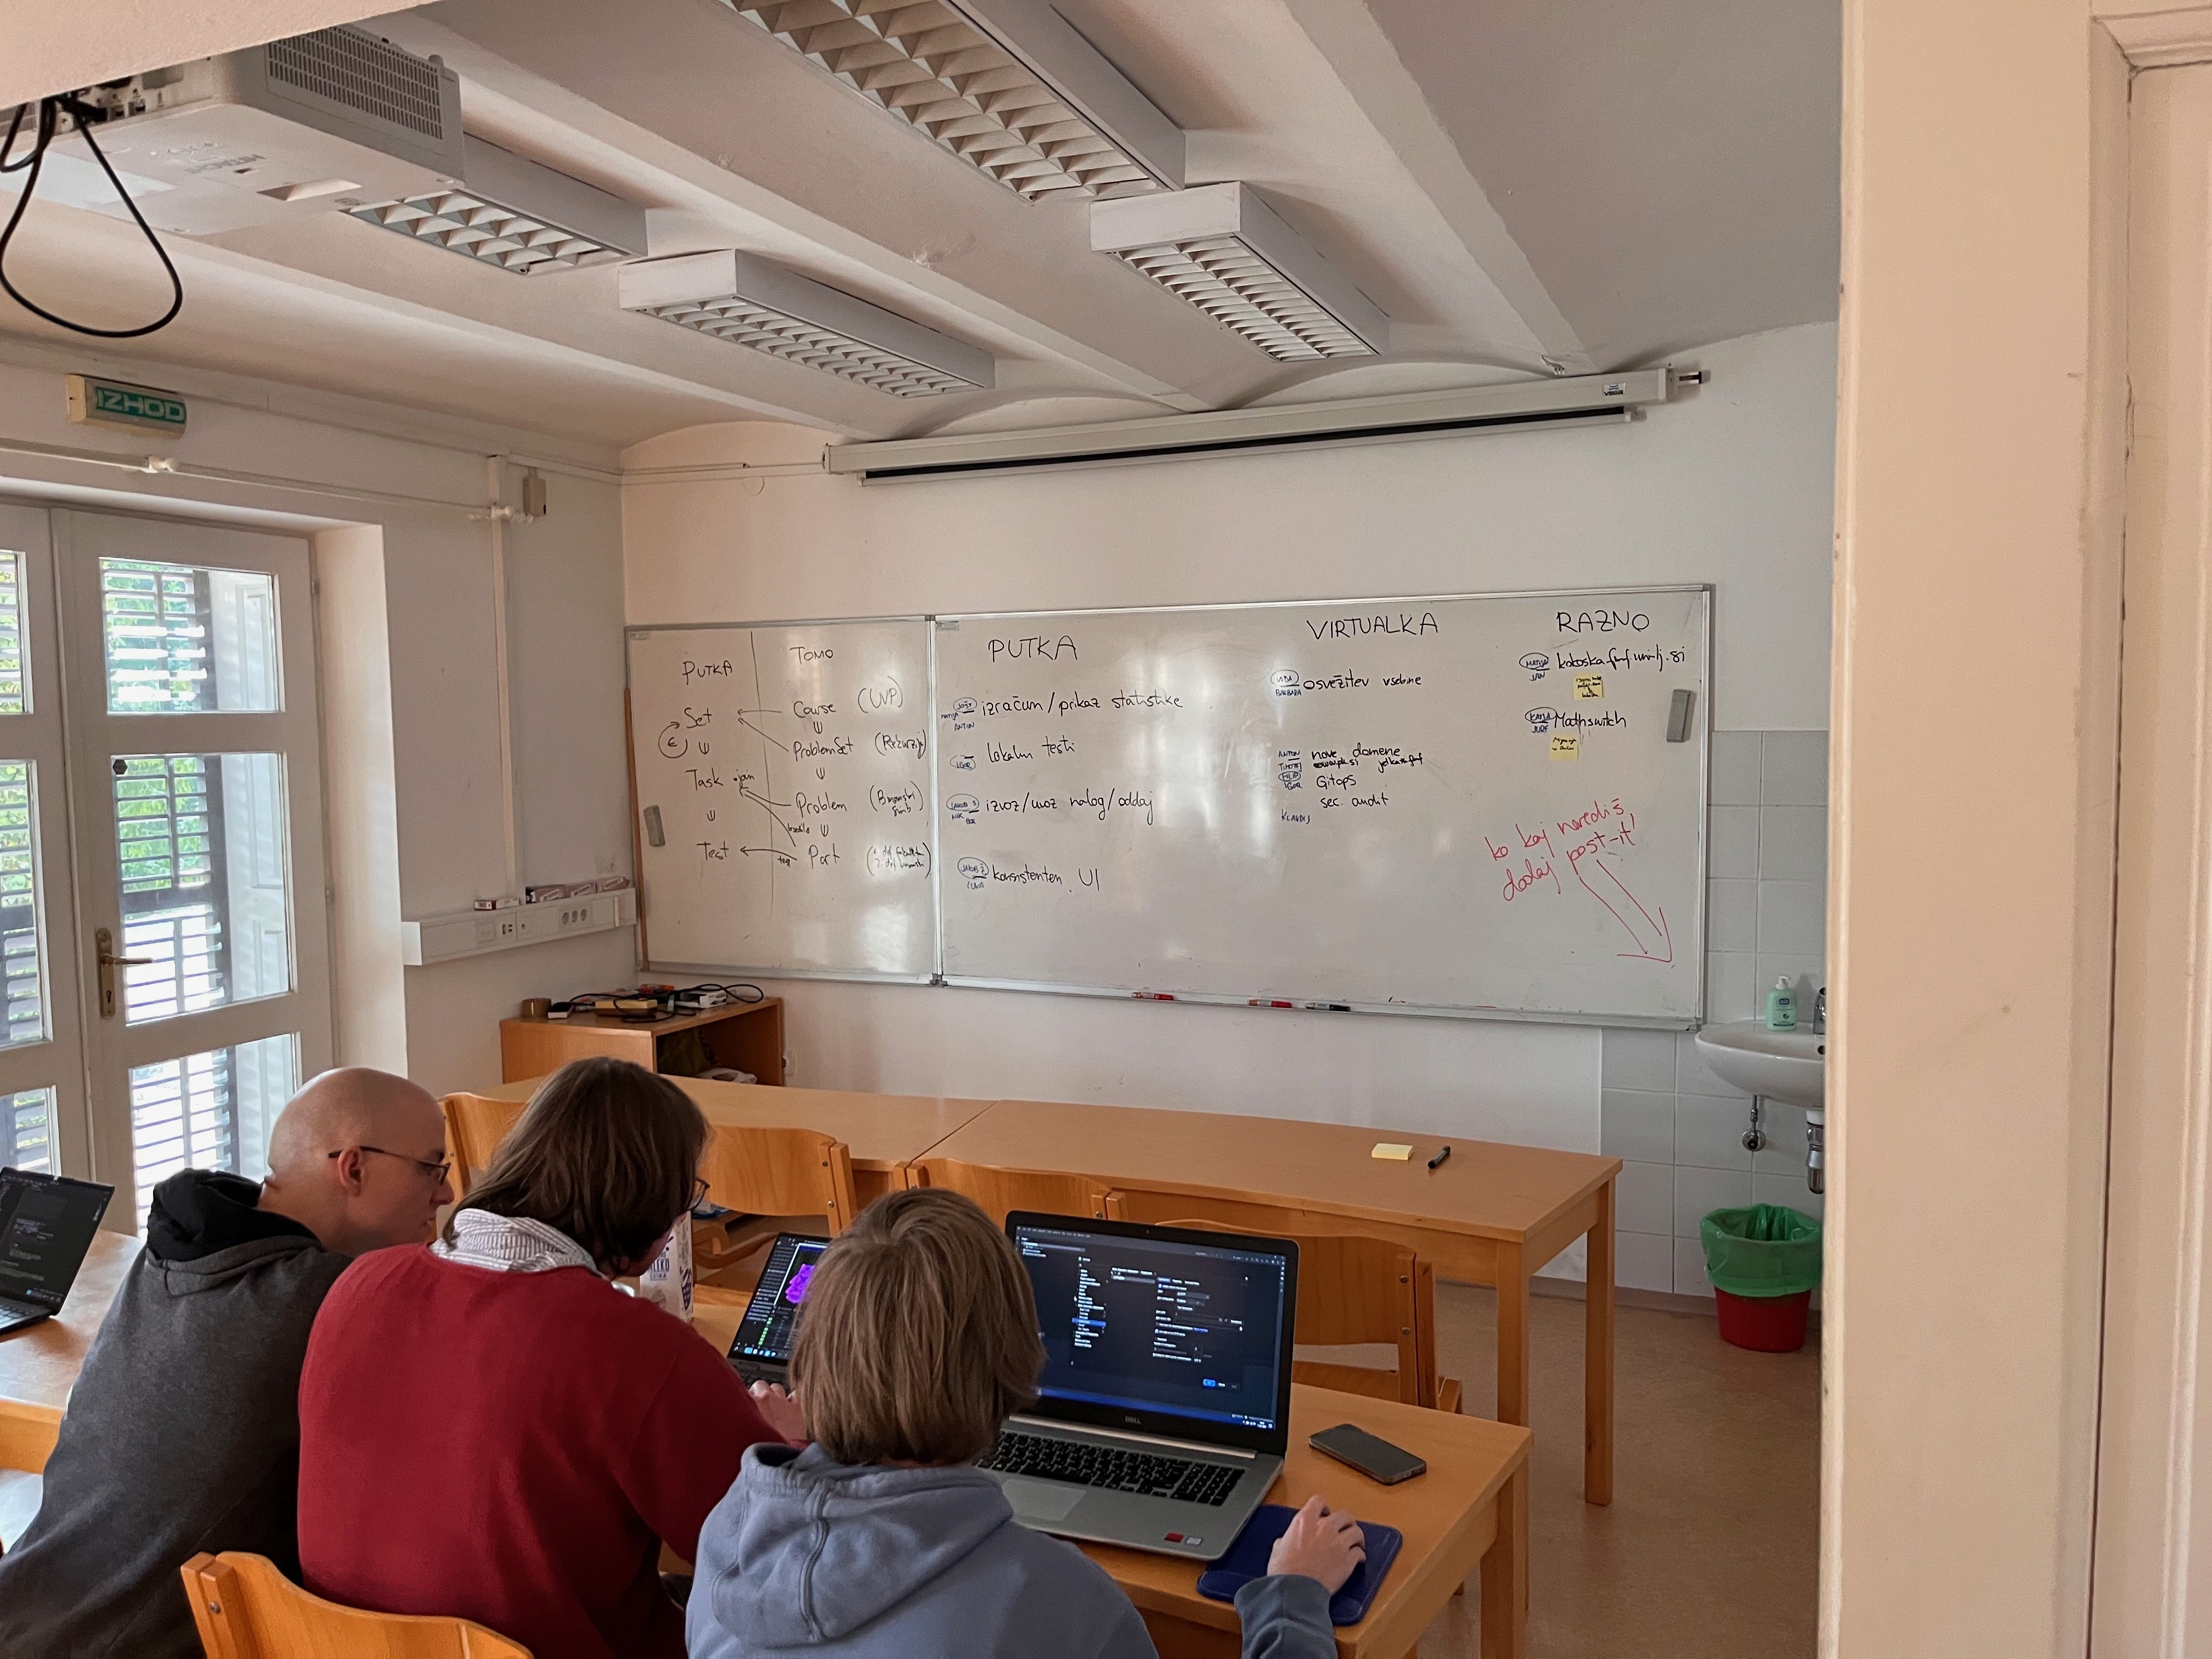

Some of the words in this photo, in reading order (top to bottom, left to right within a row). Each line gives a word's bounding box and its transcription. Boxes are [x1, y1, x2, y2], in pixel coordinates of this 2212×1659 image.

[97, 388, 185, 421] IZHOD
[1306, 612, 1438, 640] VIRTUALKA
[1556, 610, 1650, 633] RAZNO
[789, 646, 833, 665] TOMO
[988, 635, 1078, 663] PUTKA
[682, 660, 733, 685] PUTKA
[684, 707, 713, 729] Set
[793, 701, 837, 718] Course
[1311, 750, 1338, 760] nove
[1352, 742, 1401, 758] domene
[686, 767, 724, 791] Task
[795, 792, 848, 818] Problem
[1351, 792, 1389, 806] audit
[696, 840, 729, 861] Test
[808, 843, 840, 869] Part
[1503, 856, 1561, 901] dodaj
